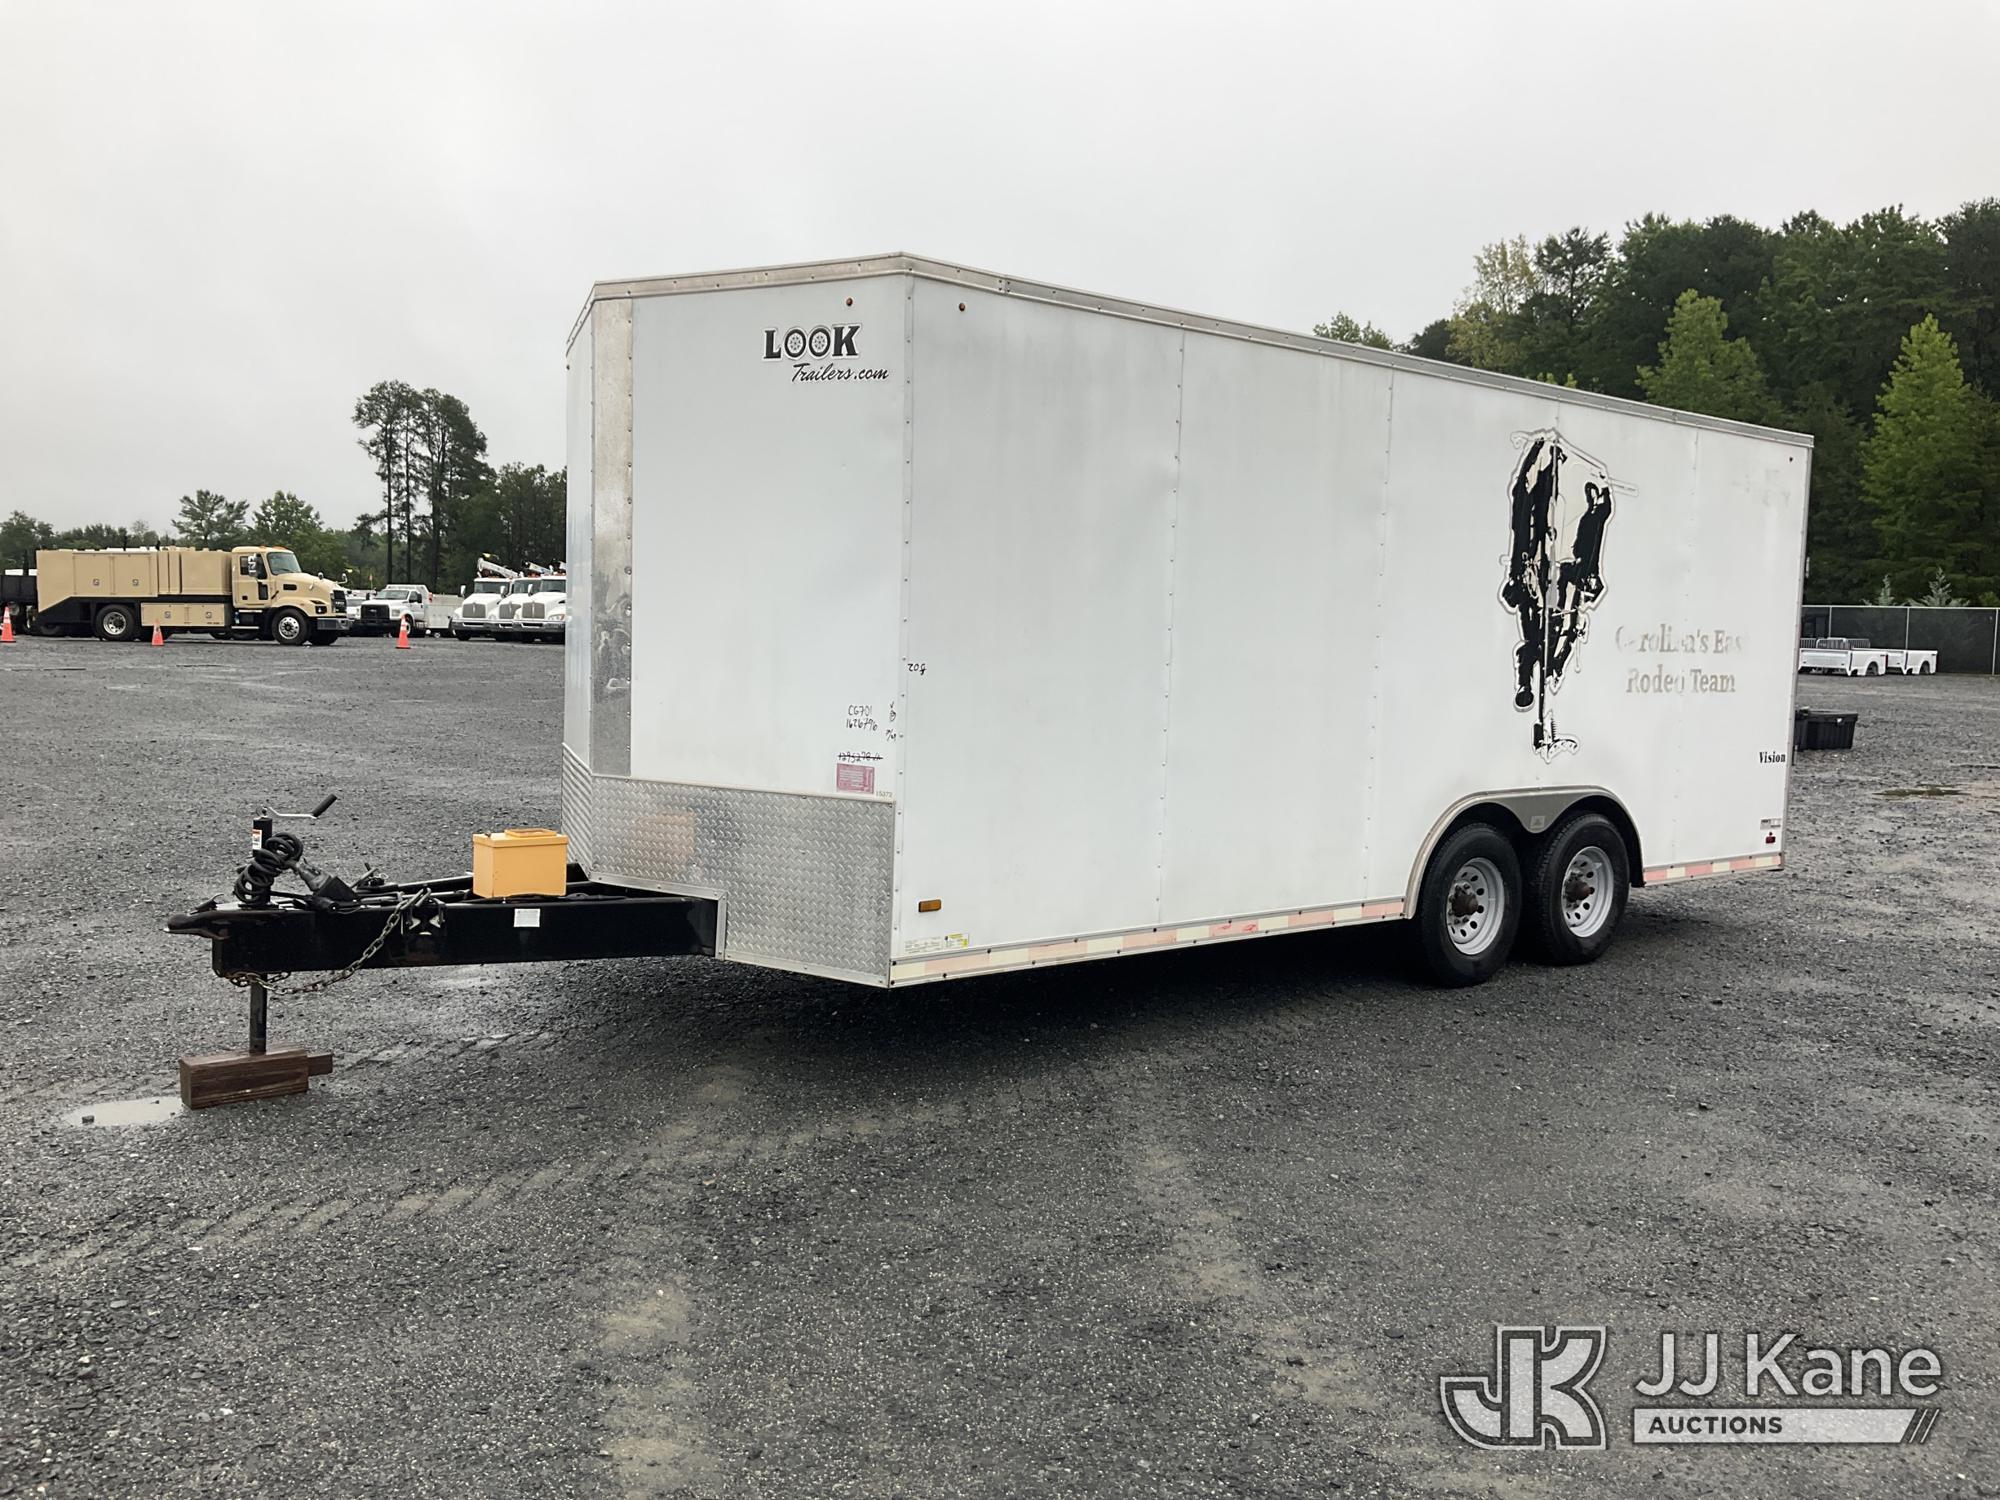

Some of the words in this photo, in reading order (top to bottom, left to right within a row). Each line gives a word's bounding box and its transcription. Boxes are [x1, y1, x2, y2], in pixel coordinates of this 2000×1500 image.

[763, 325, 860, 359] LOOK
[791, 362, 889, 382] Trailers.com
[1690, 668, 1736, 693] Team
[1759, 751, 1786, 763] Vision
